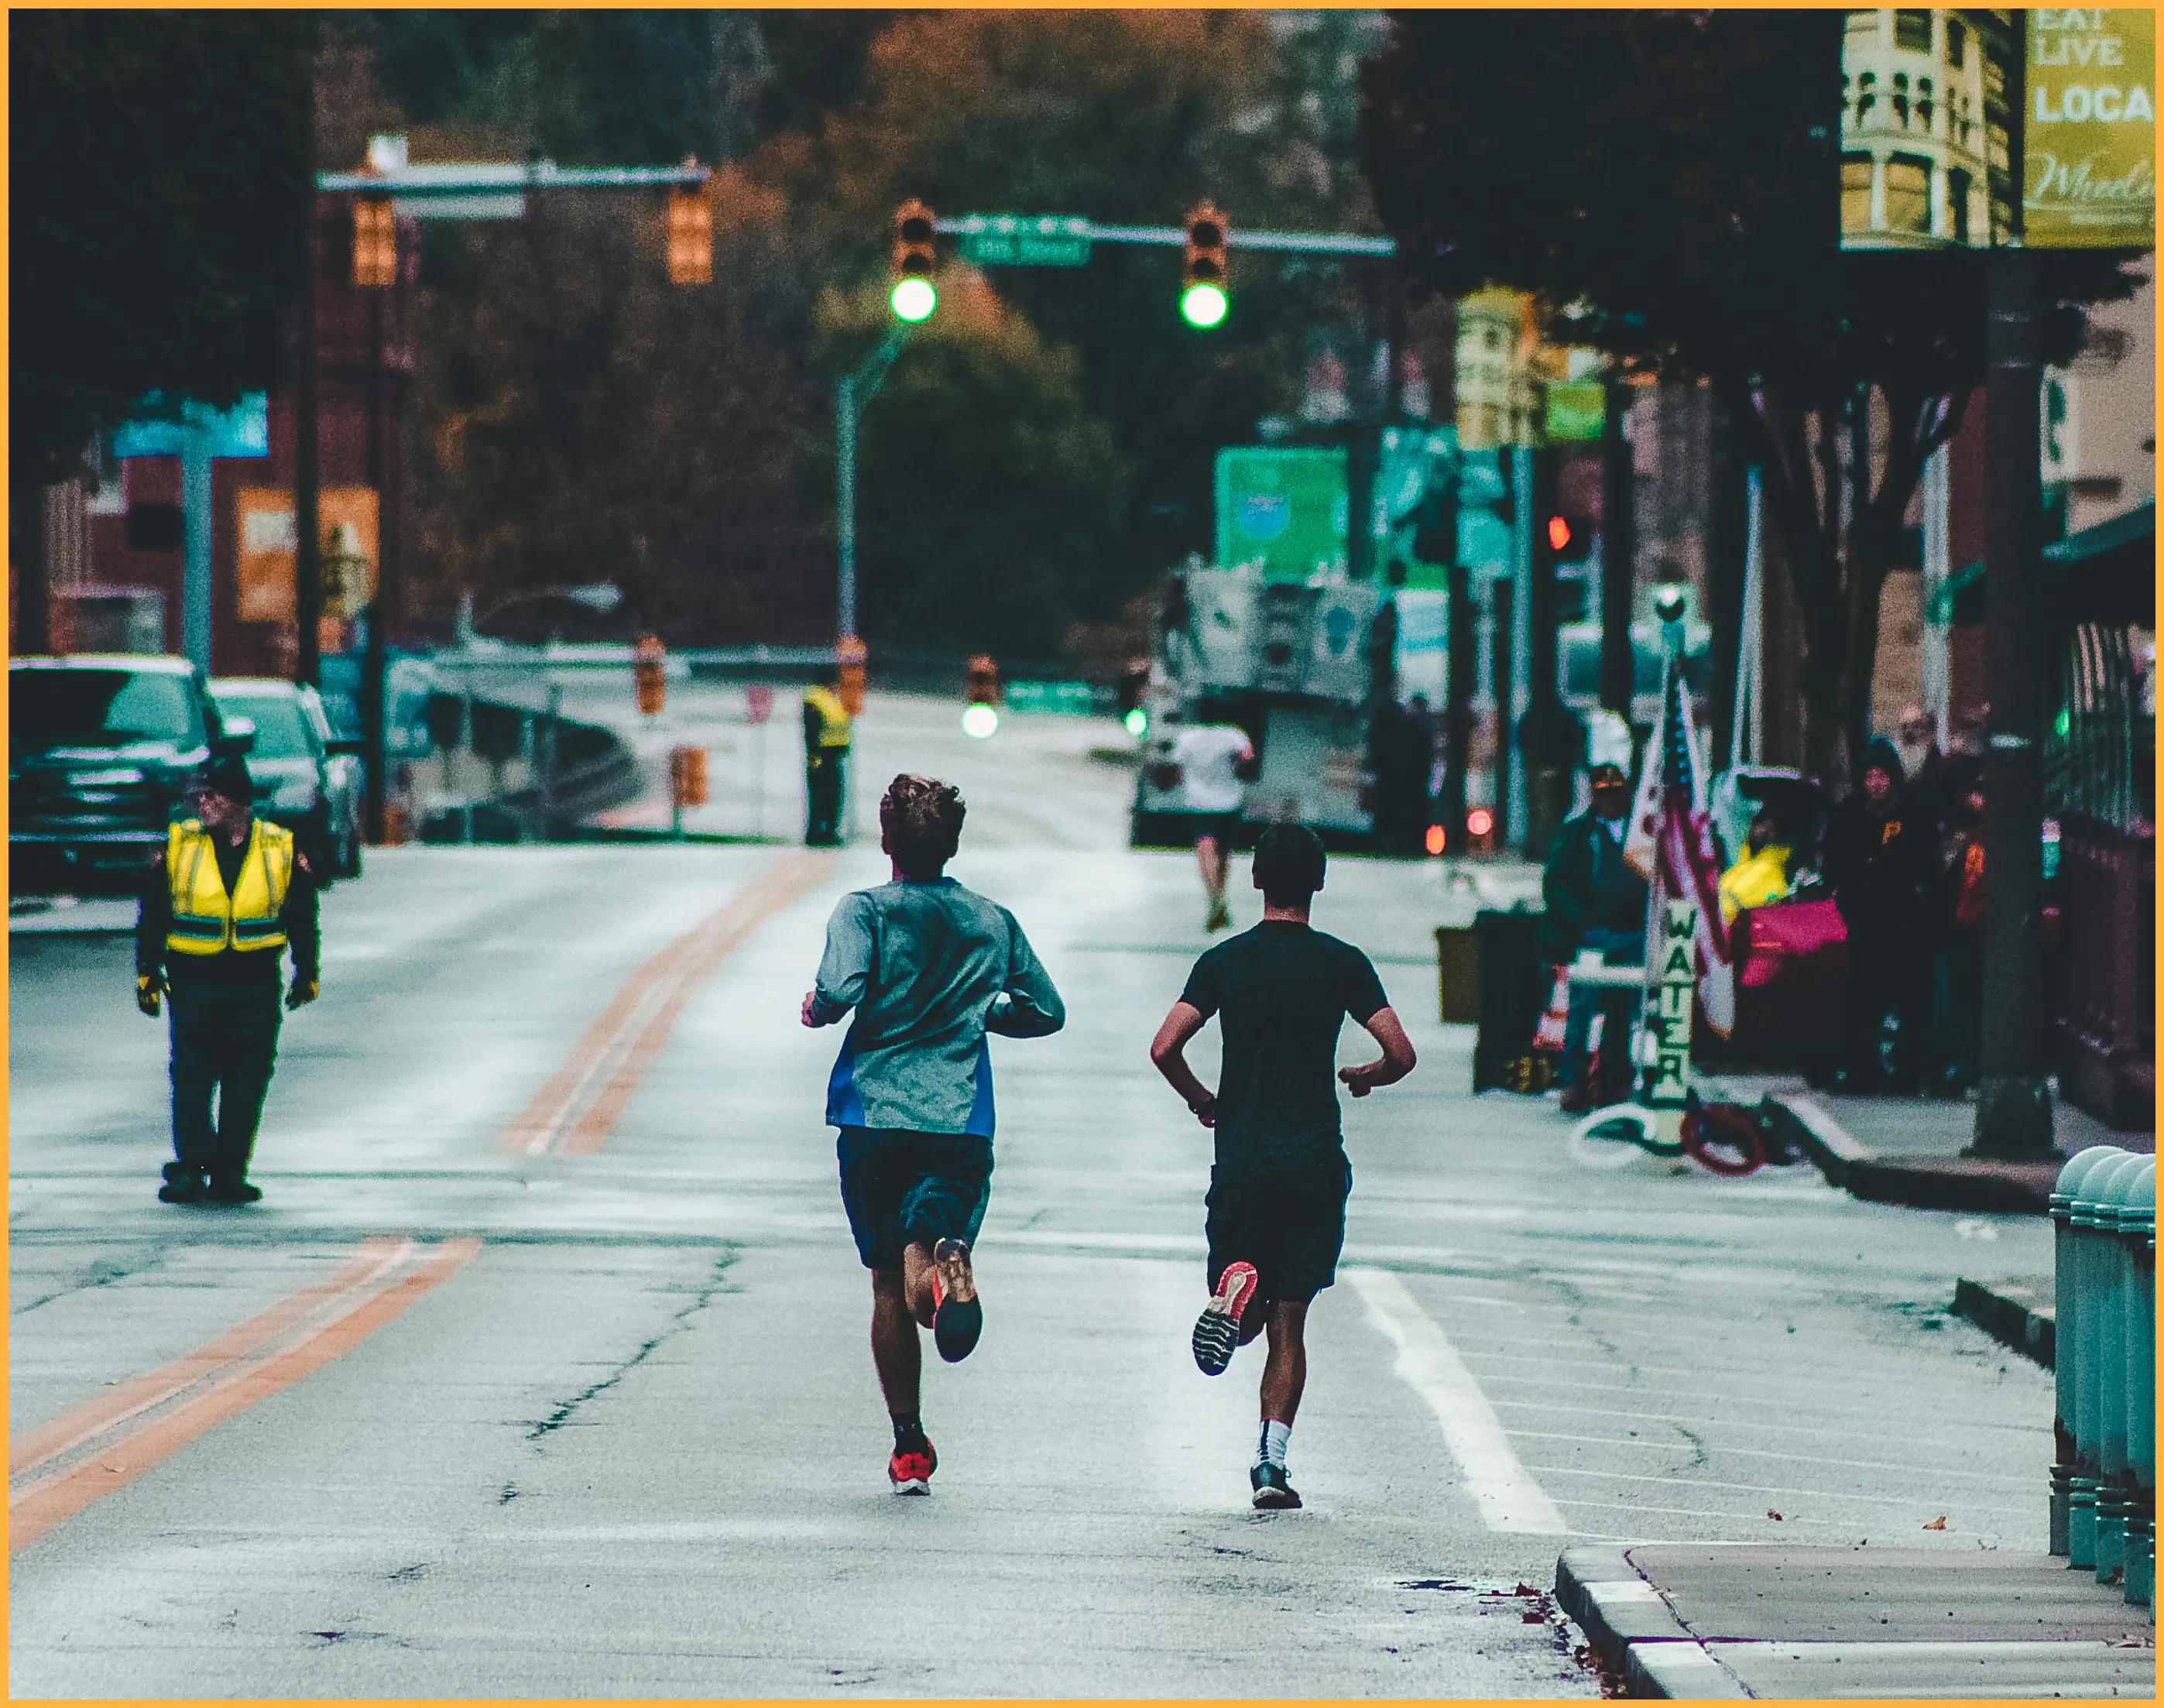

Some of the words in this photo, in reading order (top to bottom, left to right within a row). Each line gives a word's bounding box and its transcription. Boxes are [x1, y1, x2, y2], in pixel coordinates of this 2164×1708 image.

[2035, 36, 2123, 65] LIVE
[1882, 821, 1902, 845] P
[1658, 907, 1696, 1089] WATER
